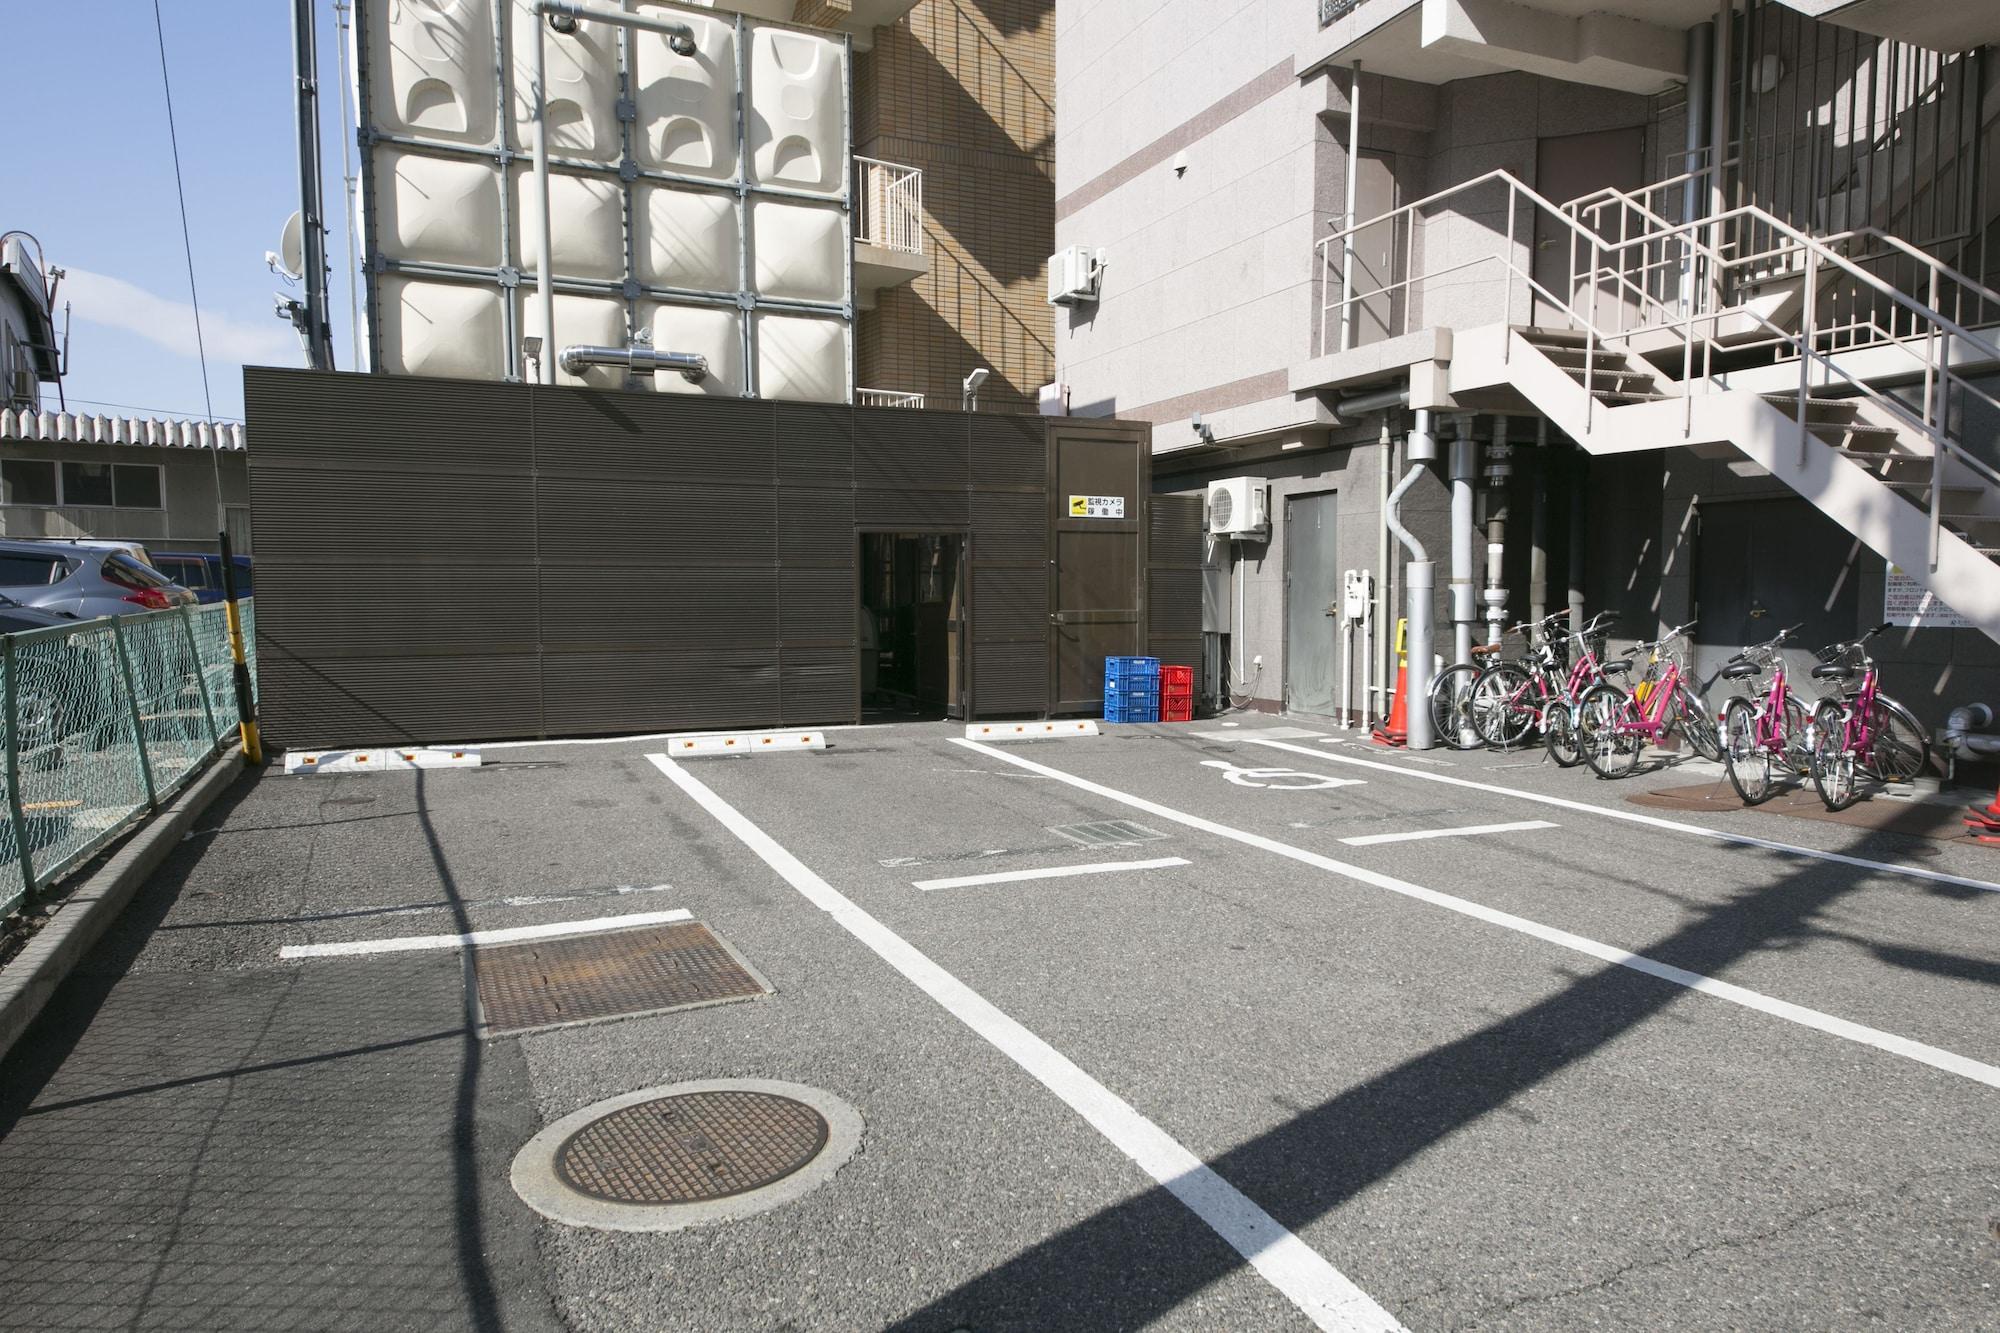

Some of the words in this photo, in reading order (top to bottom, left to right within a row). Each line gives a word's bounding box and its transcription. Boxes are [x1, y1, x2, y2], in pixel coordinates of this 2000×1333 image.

[1088, 498, 1122, 506] 監視カメラ
